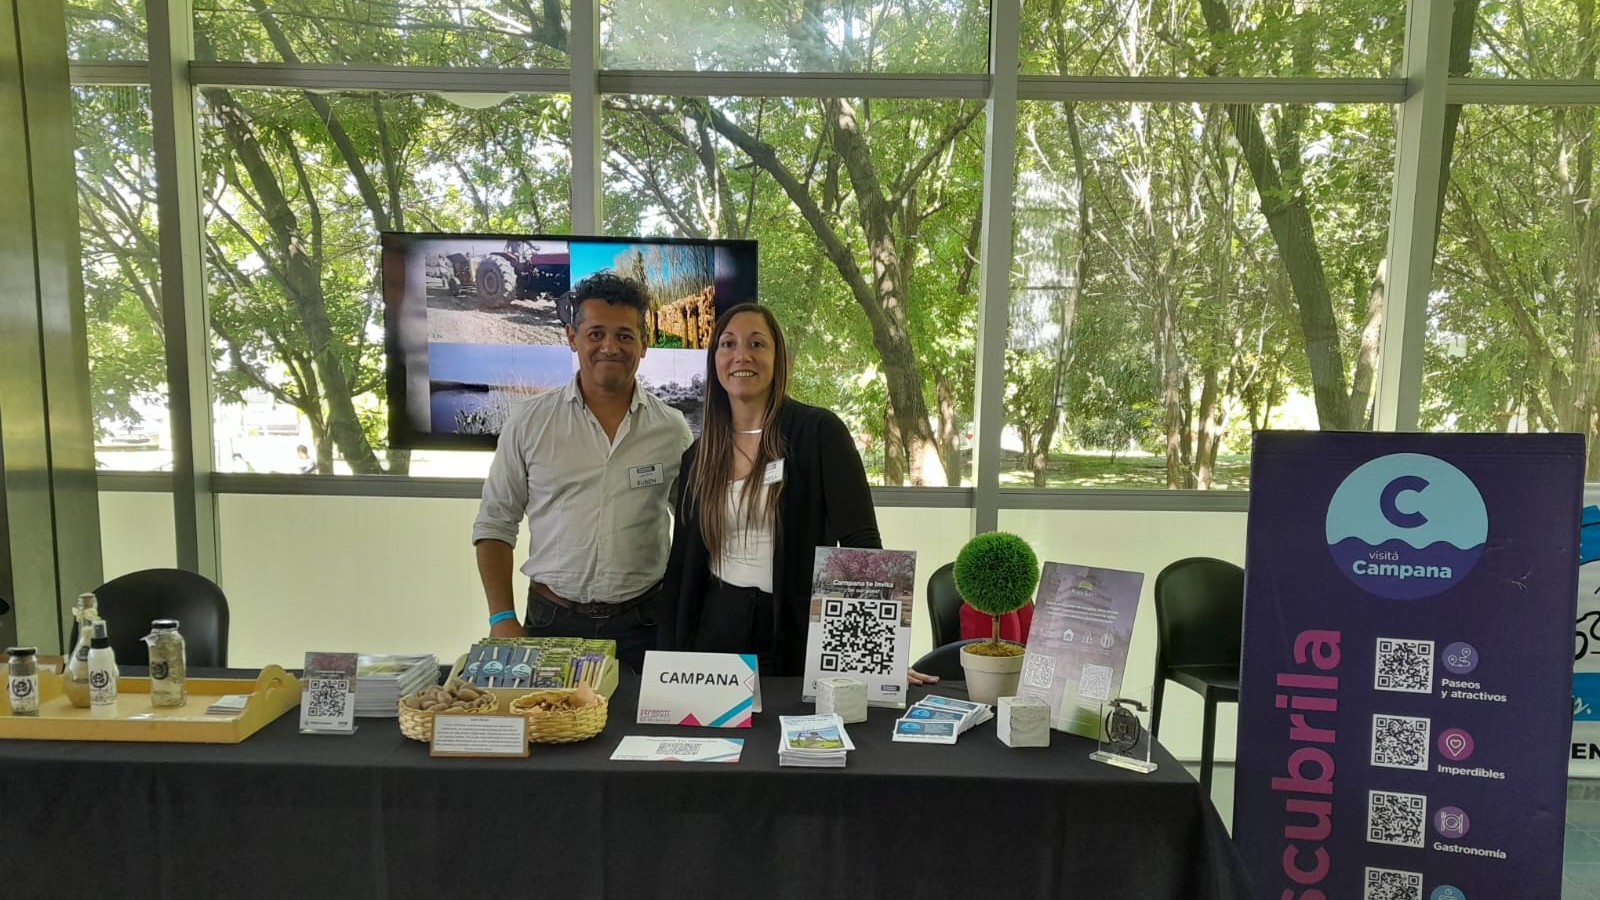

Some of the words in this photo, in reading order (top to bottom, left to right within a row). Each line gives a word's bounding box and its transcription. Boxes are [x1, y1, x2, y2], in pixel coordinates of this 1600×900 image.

[1380, 475, 1430, 528] C
[1369, 550, 1399, 561] visitá
[1352, 560, 1452, 580] Campana
[833, 579, 865, 587] Campana
[660, 671, 739, 686] CAMPANA
[1441, 678, 1481, 689] Paseos
[1440, 690, 1448, 699] y
[1450, 690, 1508, 702] atractivos
[1438, 763, 1506, 779] Imperdibles
[1433, 841, 1507, 859] Gastronomía
